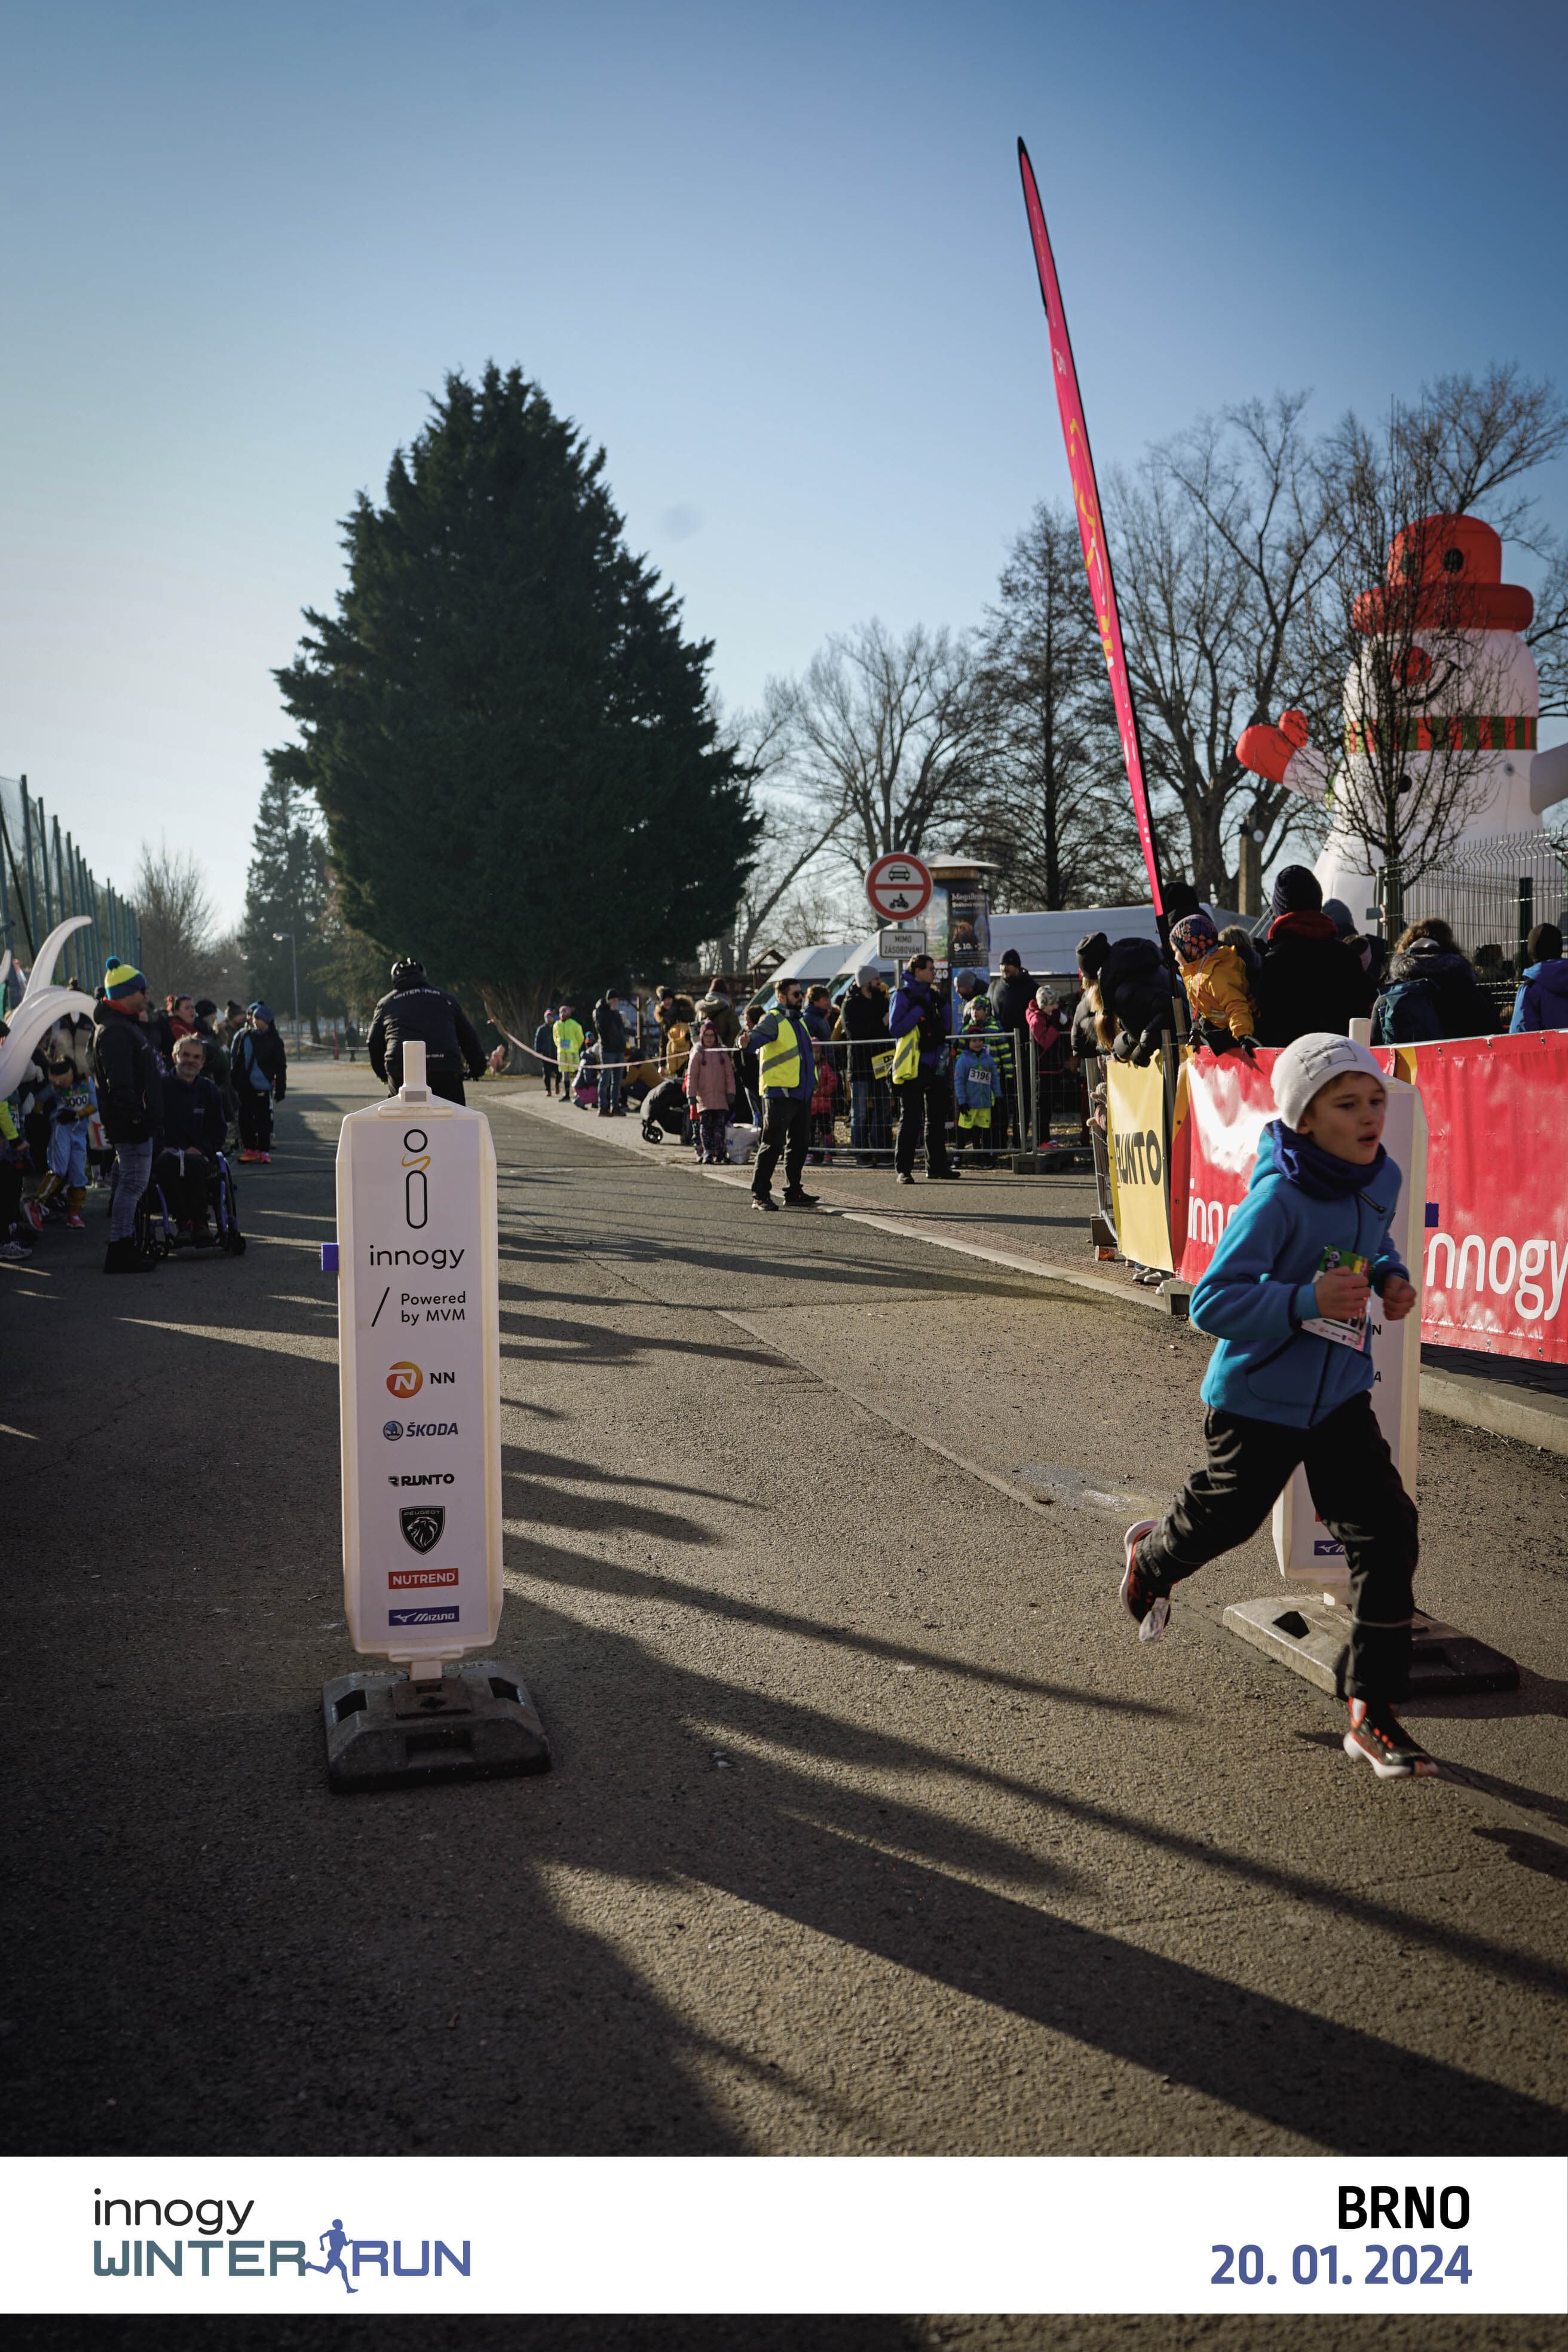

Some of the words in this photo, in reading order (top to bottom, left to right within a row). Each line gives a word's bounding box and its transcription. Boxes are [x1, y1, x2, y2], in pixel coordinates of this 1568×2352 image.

[970, 1069, 990, 1080] 3196
[1187, 1177, 1239, 1245] inn
[369, 1245, 465, 1269] innogy
[1426, 1232, 1568, 1321] nnogy
[401, 1291, 466, 1305] Powered
[401, 1310, 419, 1326] by
[426, 1309, 466, 1322] MVM
[430, 1372, 455, 1385] NN
[406, 1422, 458, 1437] ŠKODA
[401, 1474, 455, 1487] RUNTO
[393, 1572, 455, 1585] NUTREND
